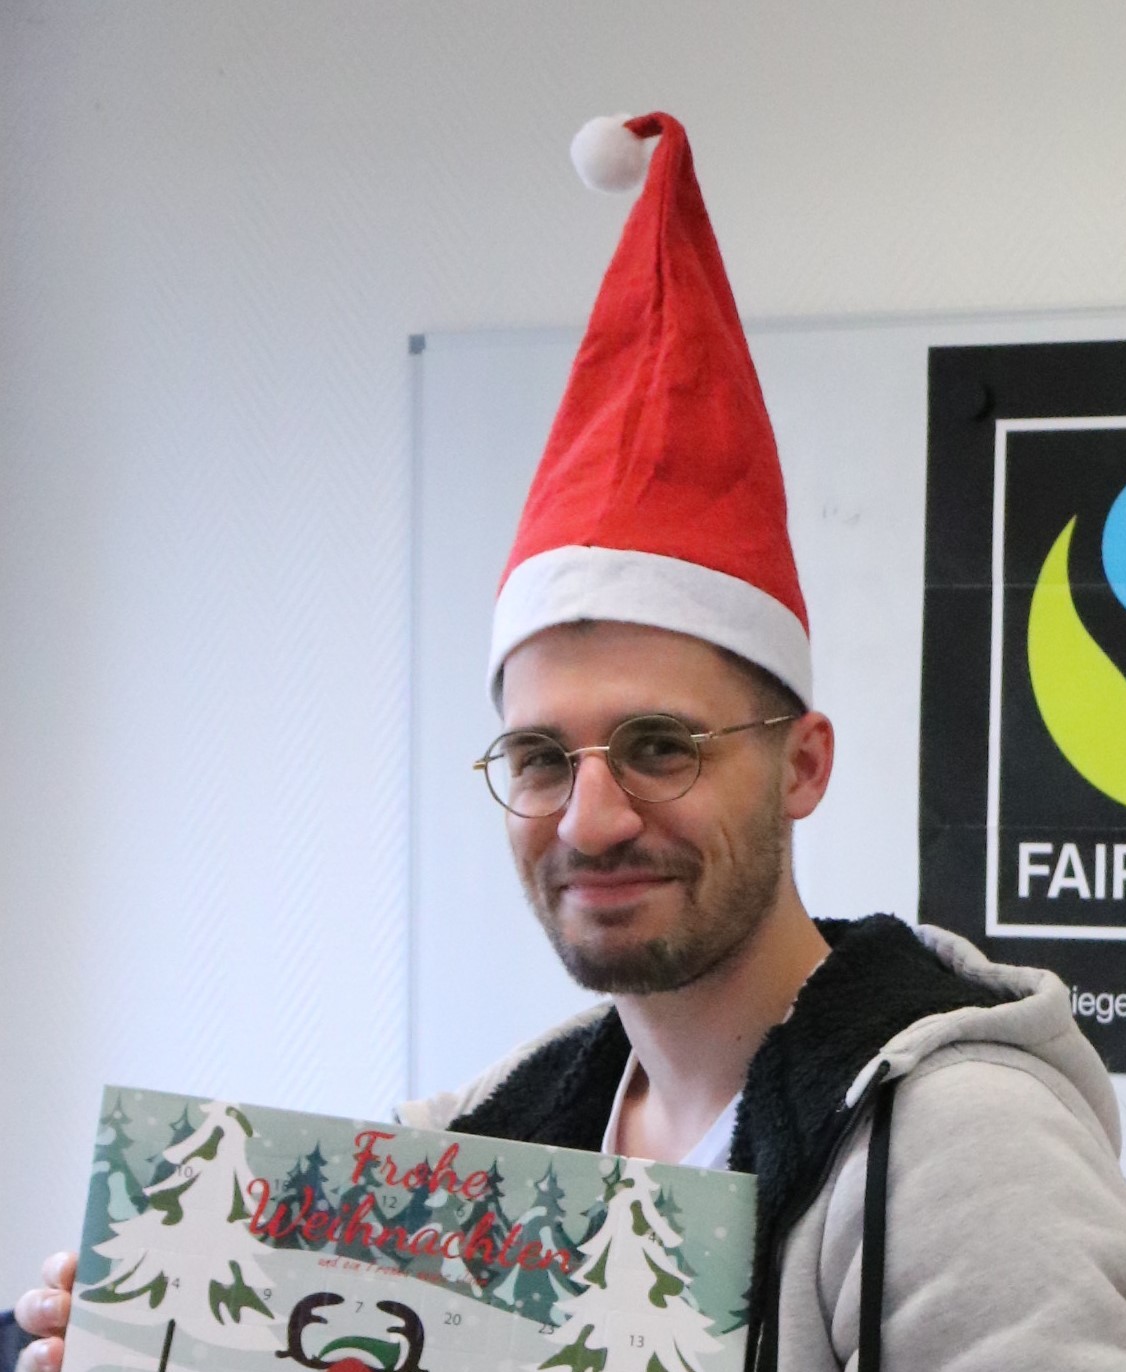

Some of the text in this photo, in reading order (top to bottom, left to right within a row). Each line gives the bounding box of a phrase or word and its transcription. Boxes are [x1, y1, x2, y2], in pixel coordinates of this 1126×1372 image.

[354, 1130, 490, 1199] Frohe
[381, 1195, 398, 1209] 12
[456, 1205, 465, 1218] 6
[247, 1178, 576, 1274] Weihnachten
[263, 1288, 272, 1300] 9
[355, 1301, 363, 1313] 7
[444, 1312, 461, 1325] 20
[629, 1335, 645, 1348] 13
